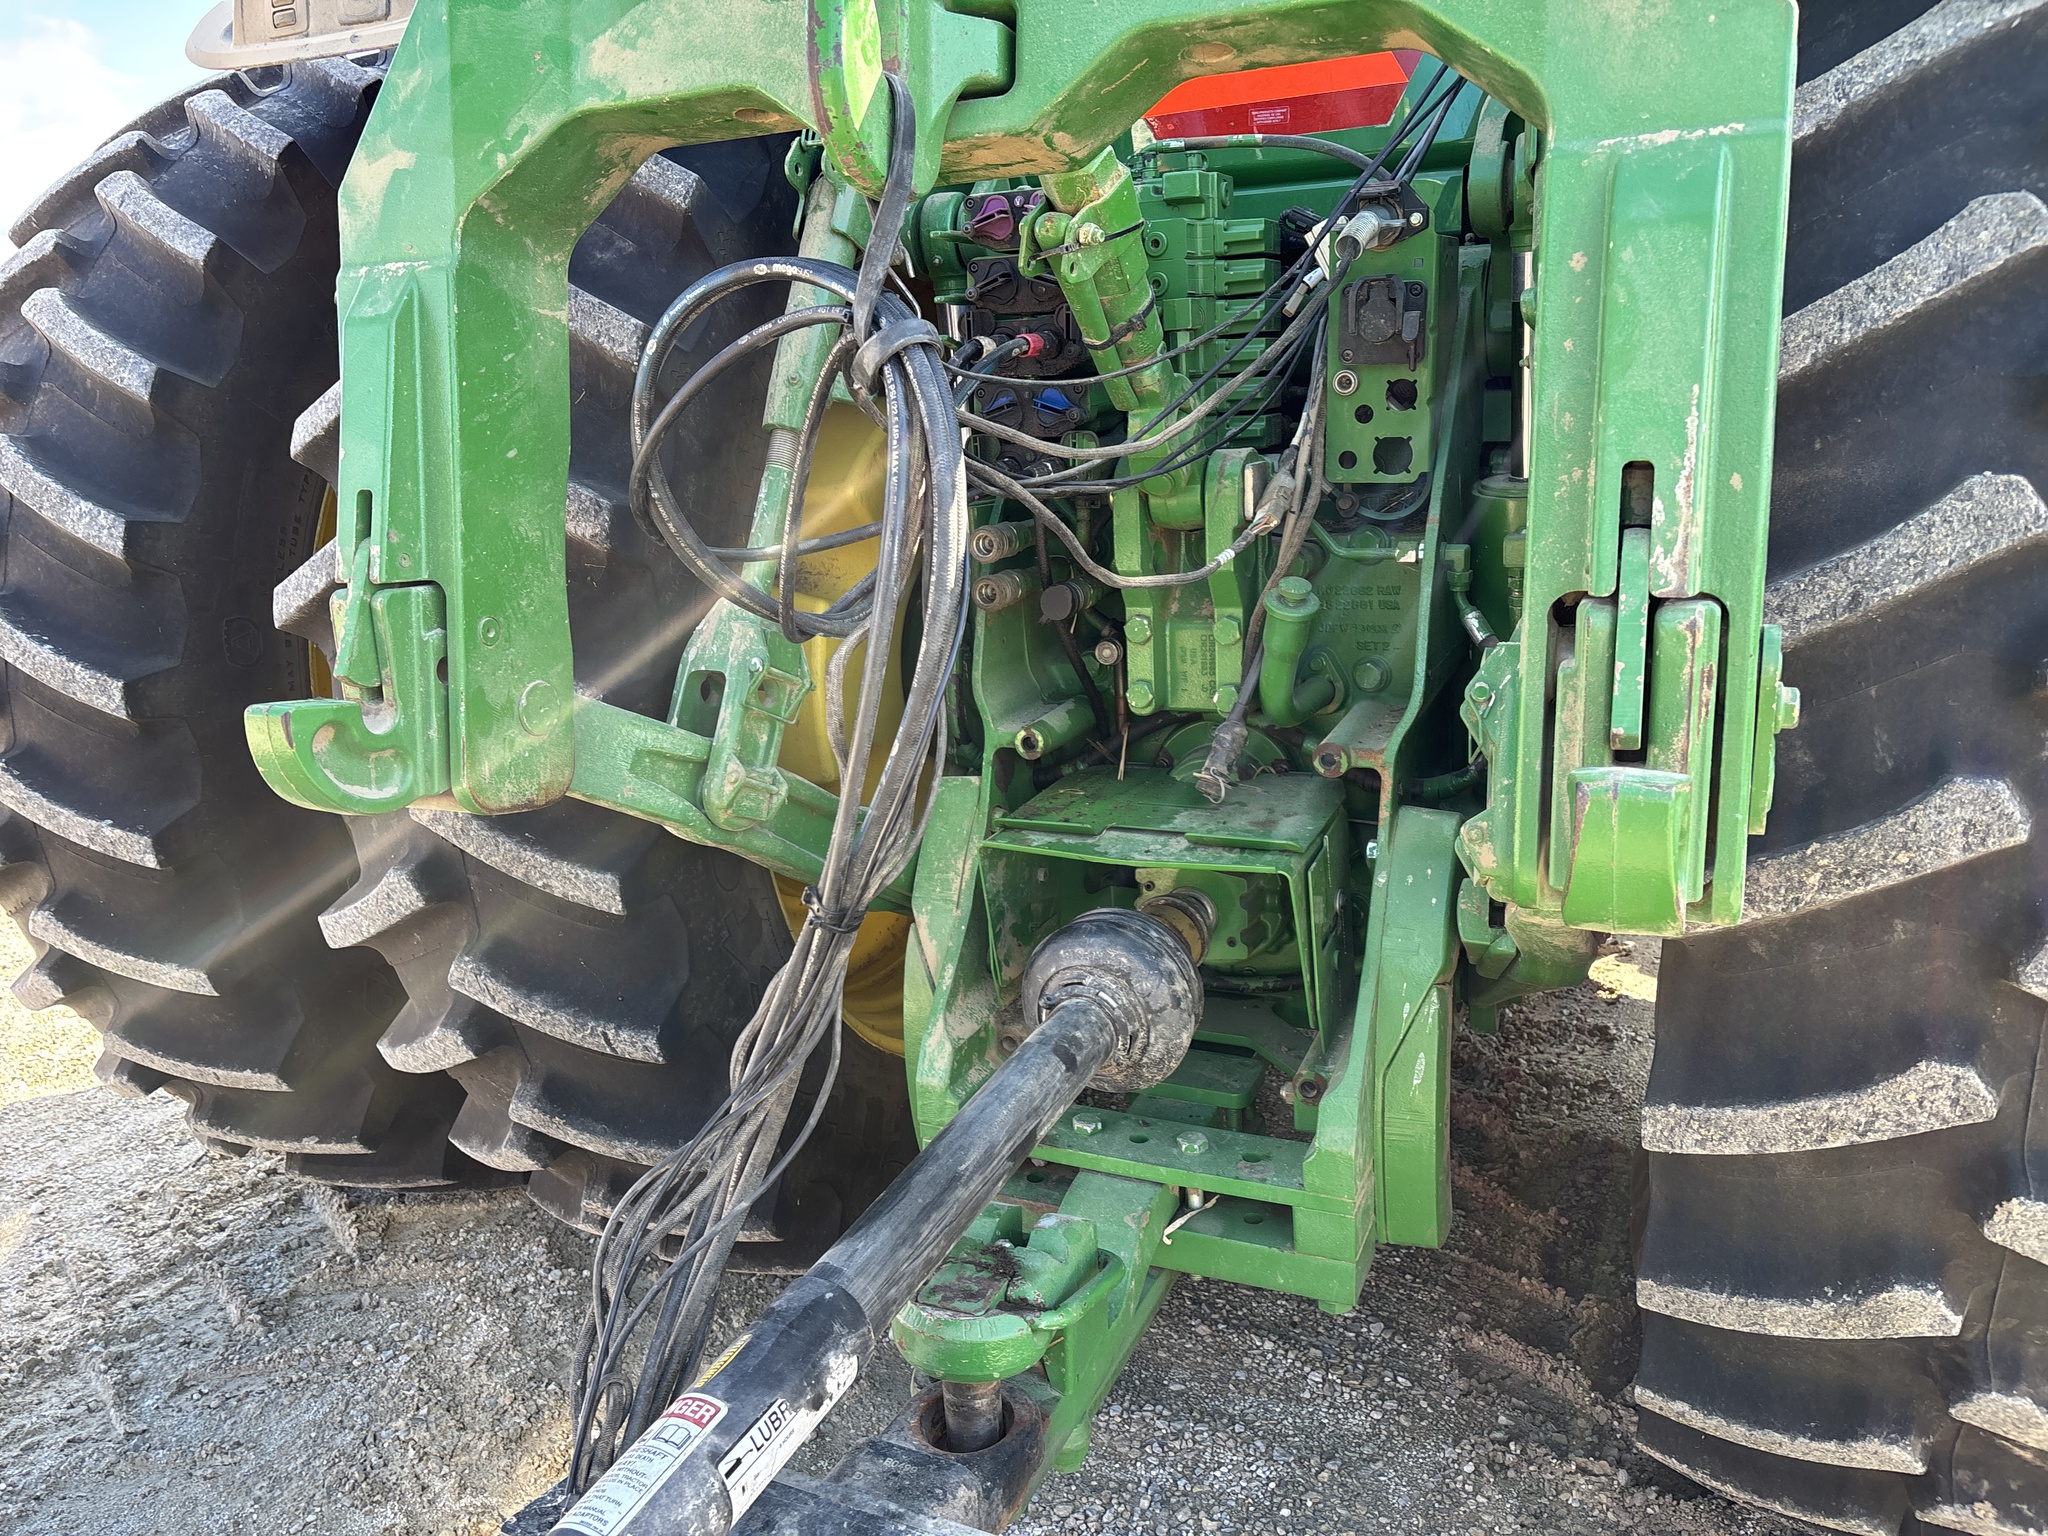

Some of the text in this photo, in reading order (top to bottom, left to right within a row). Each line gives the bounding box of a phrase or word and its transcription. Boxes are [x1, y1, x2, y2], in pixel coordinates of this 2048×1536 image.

[887, 384, 897, 399] PSI
[1356, 641, 1380, 651] SET
[962, 1319, 998, 1341] PIN
[750, 1400, 793, 1452] LUBR
[635, 1453, 654, 1464] DEATH
[621, 1474, 649, 1490] TRACTOR
[624, 1481, 644, 1494] PLACE
[606, 1496, 622, 1508] TURN
[583, 1505, 606, 1517] MANUAL
[573, 1511, 609, 1527] ADAPTORS
